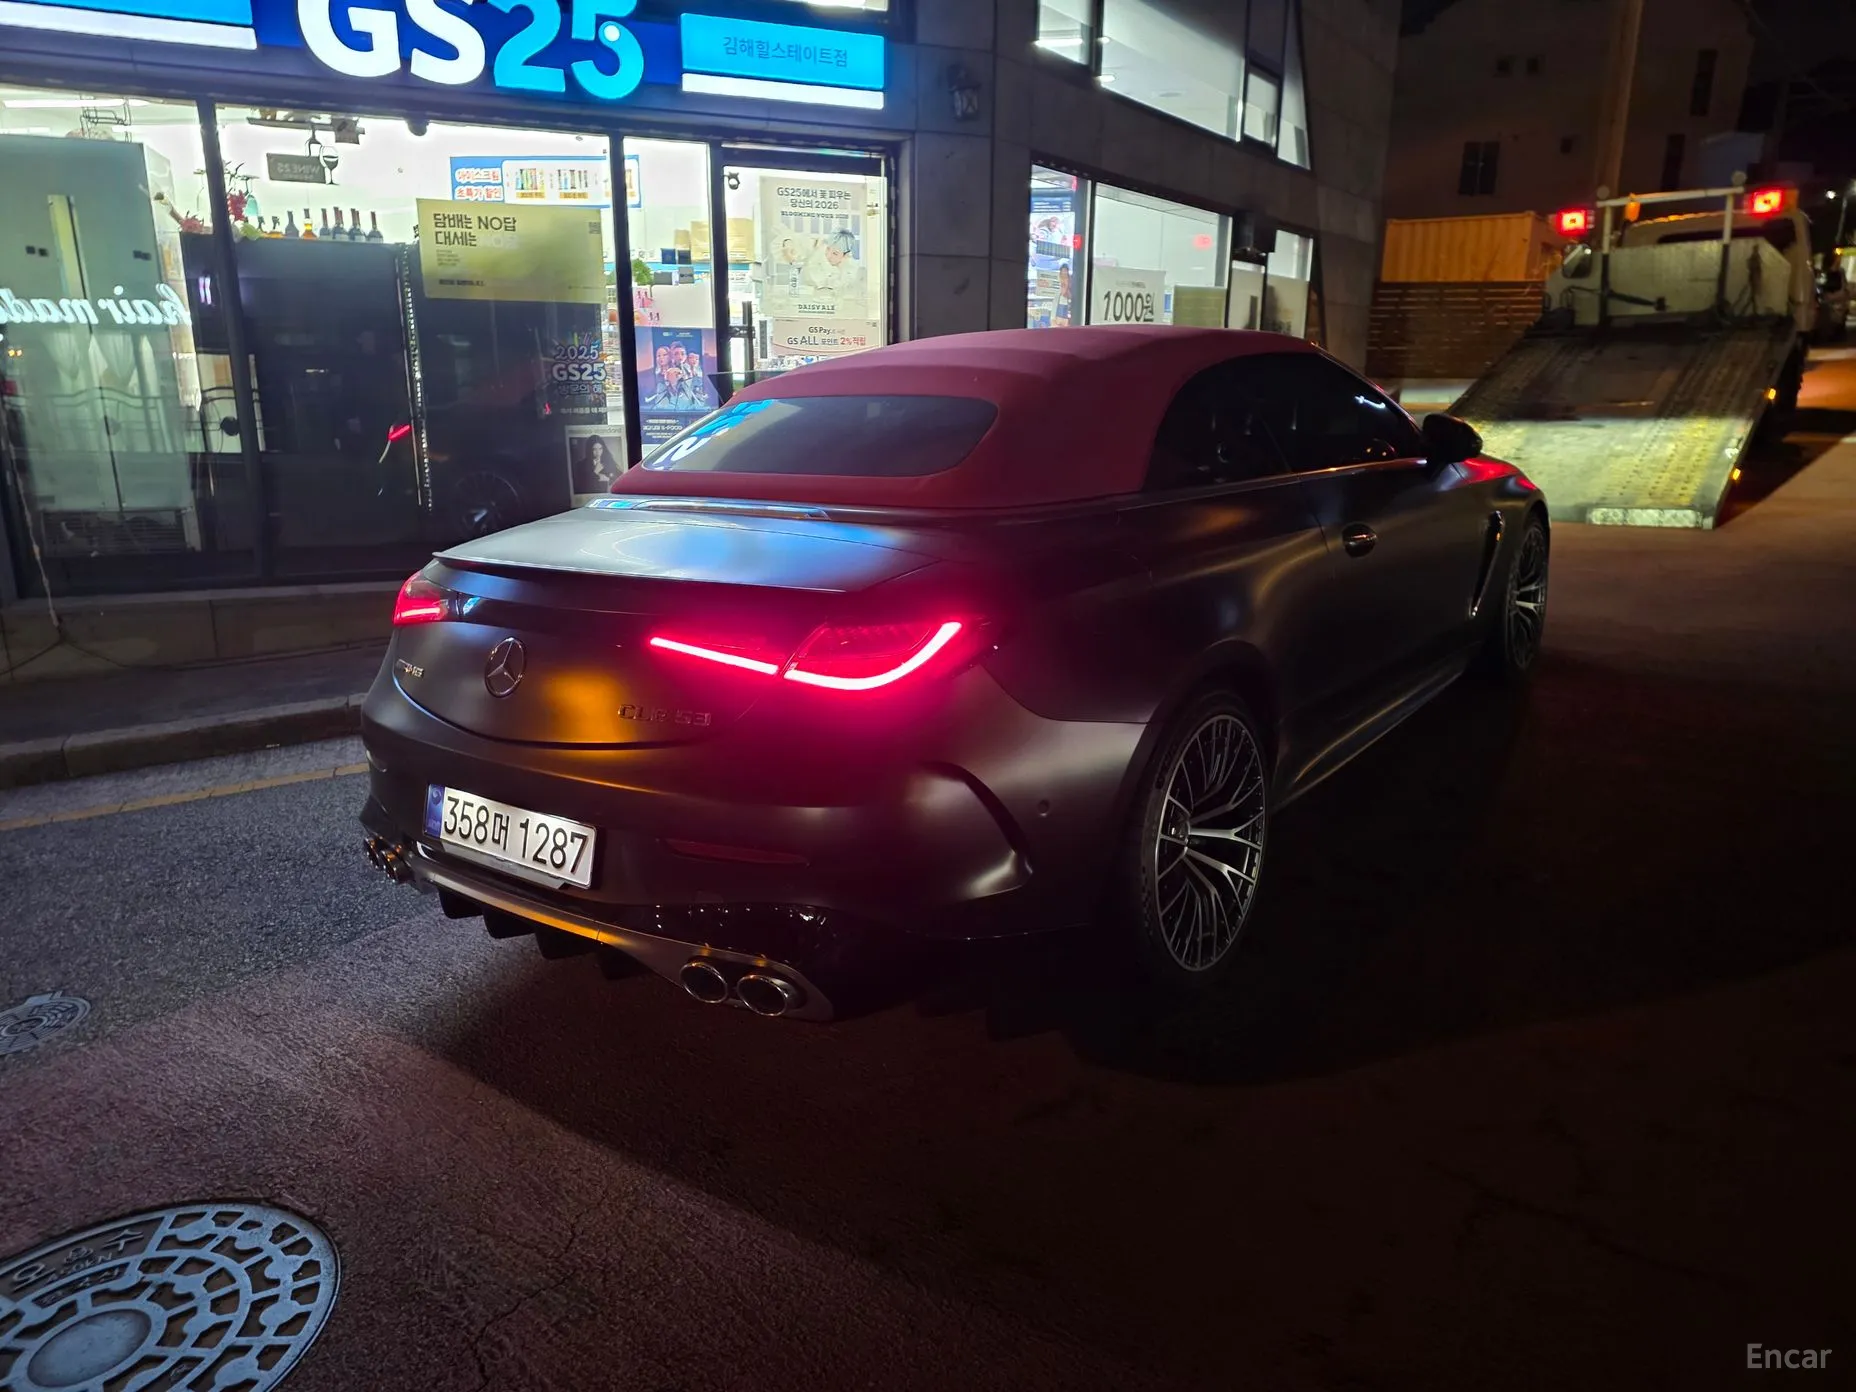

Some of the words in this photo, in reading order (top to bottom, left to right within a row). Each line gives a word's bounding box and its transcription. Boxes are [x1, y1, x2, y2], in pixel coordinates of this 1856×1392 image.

[297, 0, 644, 99] GS25
[723, 36, 848, 68] 김해힐스테이트점
[789, 198, 814, 209] 당신의
[814, 200, 839, 210] 2026
[433, 213, 473, 229] 담배는
[477, 215, 517, 232] NO답
[435, 231, 478, 247] 대세는
[787, 337, 799, 345] GS
[799, 335, 820, 346] ALL
[556, 345, 600, 360] 2025
[552, 362, 607, 381] GS25
[443, 796, 510, 851] 358머
[518, 817, 590, 874] 1287
